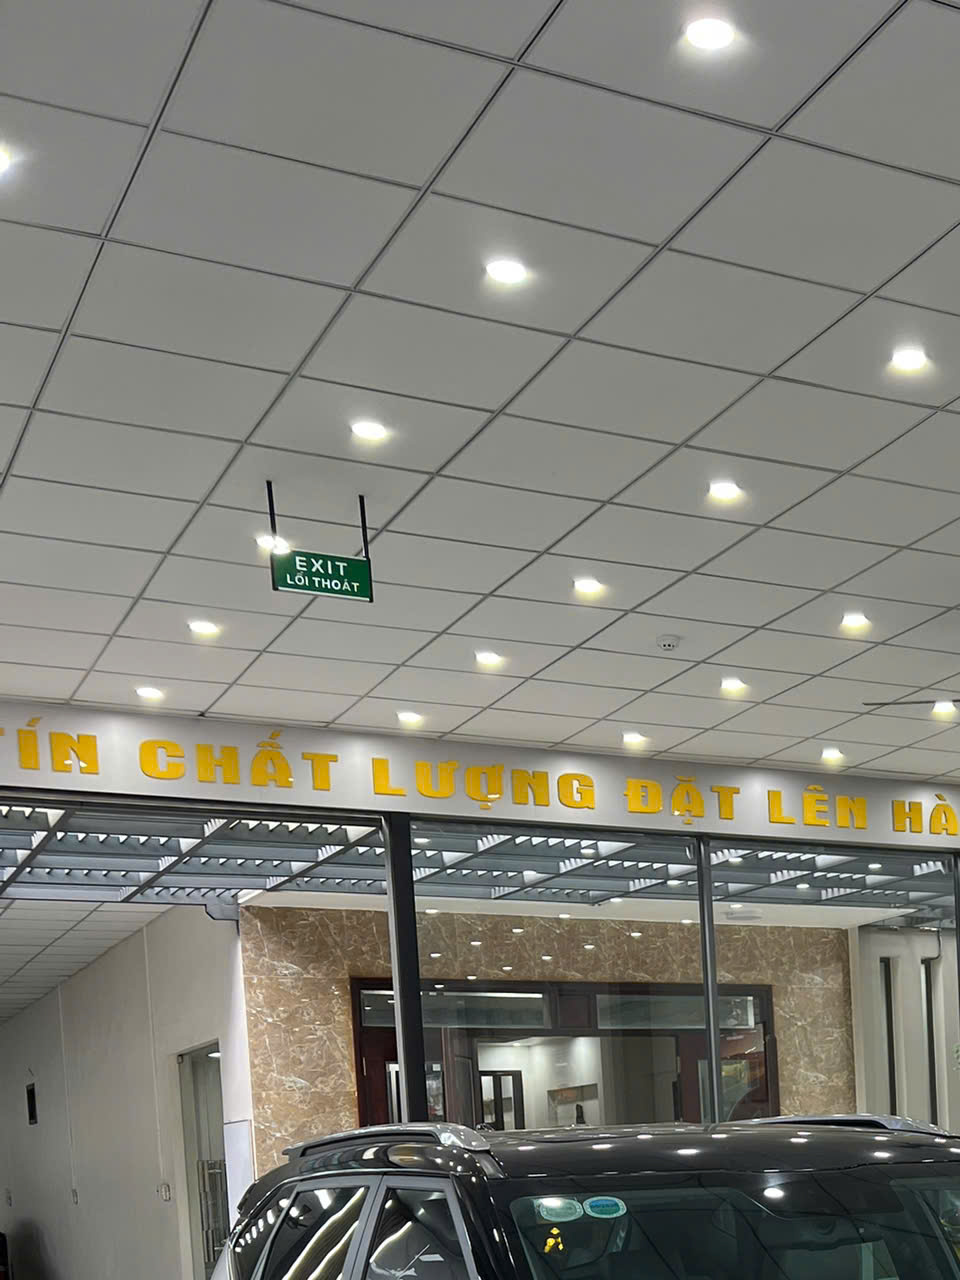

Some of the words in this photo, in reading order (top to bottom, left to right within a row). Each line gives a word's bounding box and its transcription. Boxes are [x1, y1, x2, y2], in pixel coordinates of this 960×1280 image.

[295, 556, 347, 576] EXIT
[312, 576, 360, 592] THOÁT
[0, 716, 100, 775] ÍN
[138, 729, 339, 792] CHẤT
[371, 757, 596, 810] LƯỢNG
[623, 775, 741, 825] ĐẶT
[767, 785, 869, 830] LÊN
